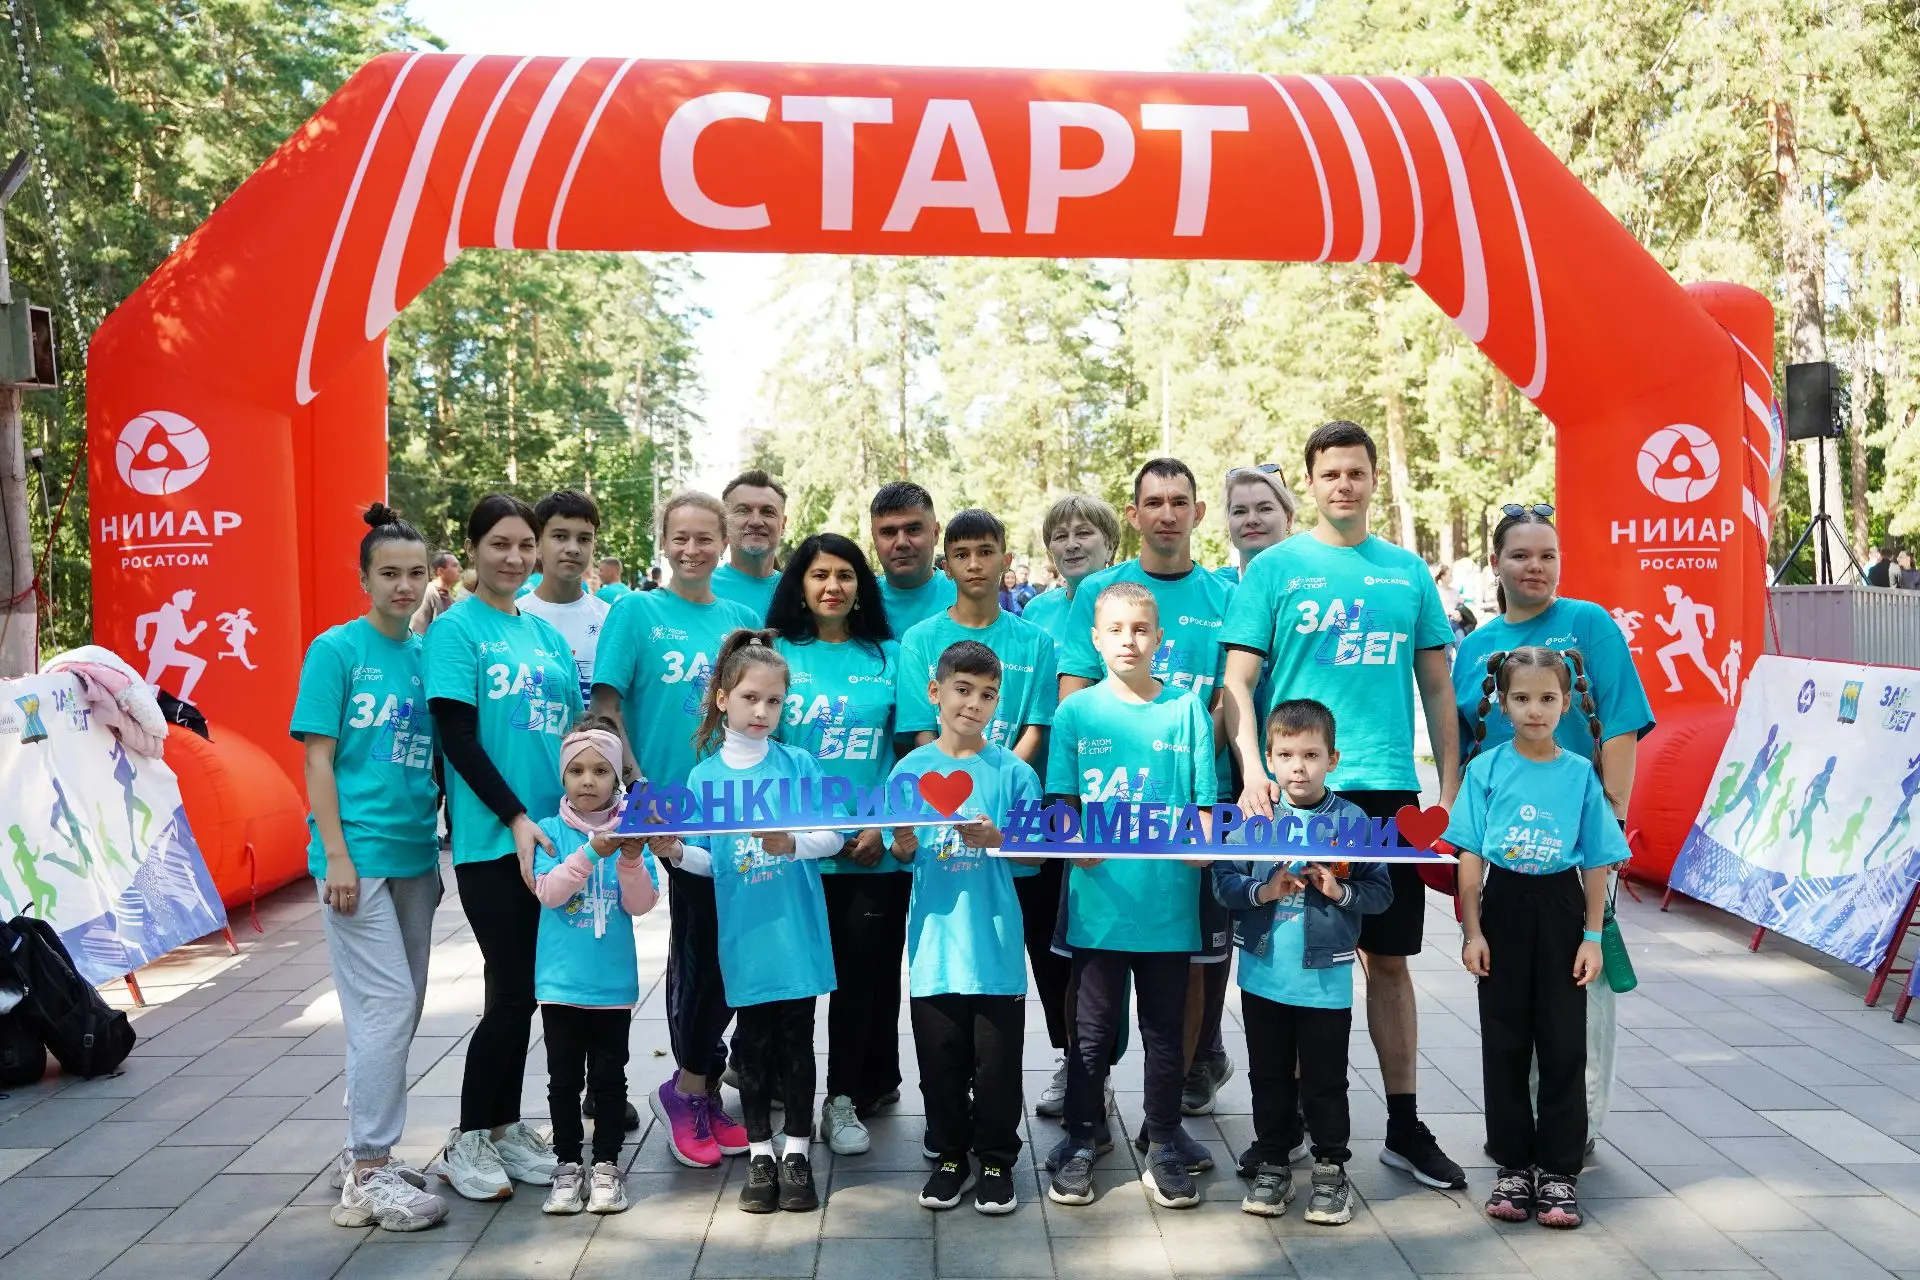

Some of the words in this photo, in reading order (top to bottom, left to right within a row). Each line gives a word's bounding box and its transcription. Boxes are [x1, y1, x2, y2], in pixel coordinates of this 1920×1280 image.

[660, 91, 1249, 237] СТАРТ
[101, 510, 242, 543] НИИАР
[1611, 517, 1735, 544] НИИАР
[121, 553, 209, 569] РОСАТОМ
[1640, 557, 1718, 571] РОСАТОМ
[1295, 598, 1365, 634] ЗА!
[1334, 631, 1409, 666] БЕГ
[661, 650, 718, 684] ЗА
[784, 693, 849, 726] ЗА!
[818, 727, 884, 760] БЕГ
[1088, 746, 1112, 755] СПОРТ
[1000, 798, 1399, 850] #ФМБАРоссии
[1504, 826, 1540, 845] ЗА!
[1520, 843, 1561, 863] БЕГ
